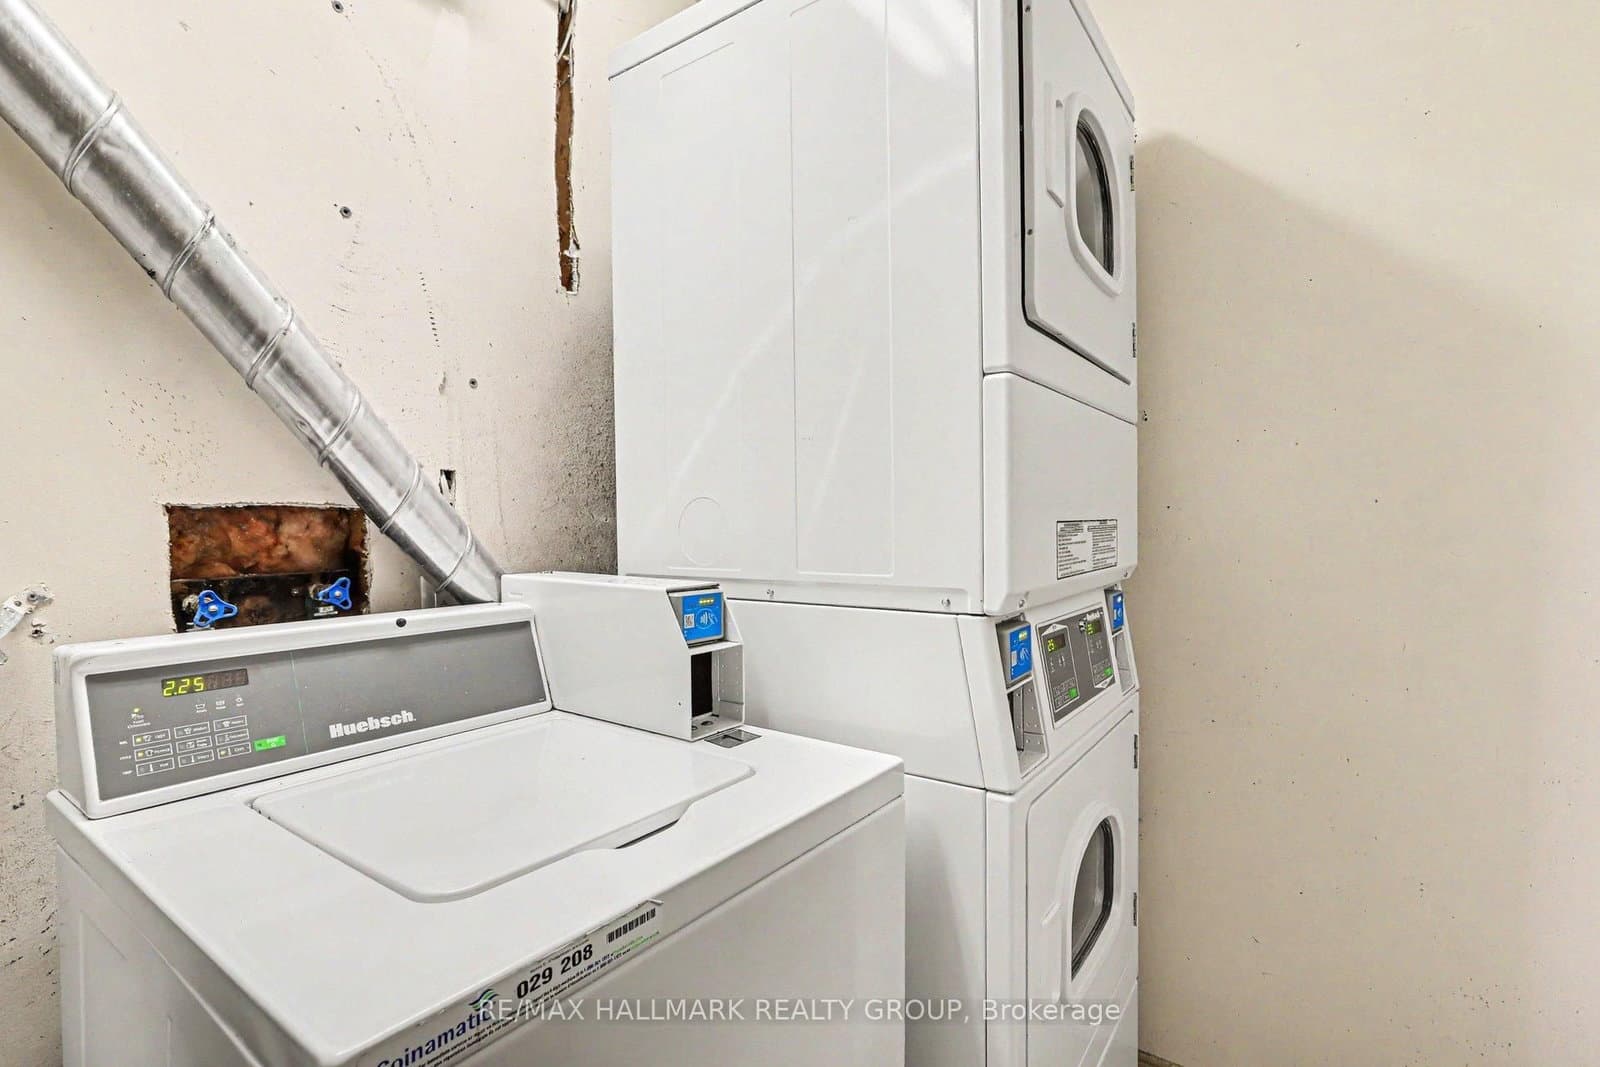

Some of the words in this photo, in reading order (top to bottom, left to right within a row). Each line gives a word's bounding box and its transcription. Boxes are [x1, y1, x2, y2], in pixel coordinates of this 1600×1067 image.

[163, 677, 205, 697] 2.25
[329, 710, 414, 738] Huebsch
[517, 966, 553, 999] 029
[560, 944, 593, 974] 208
